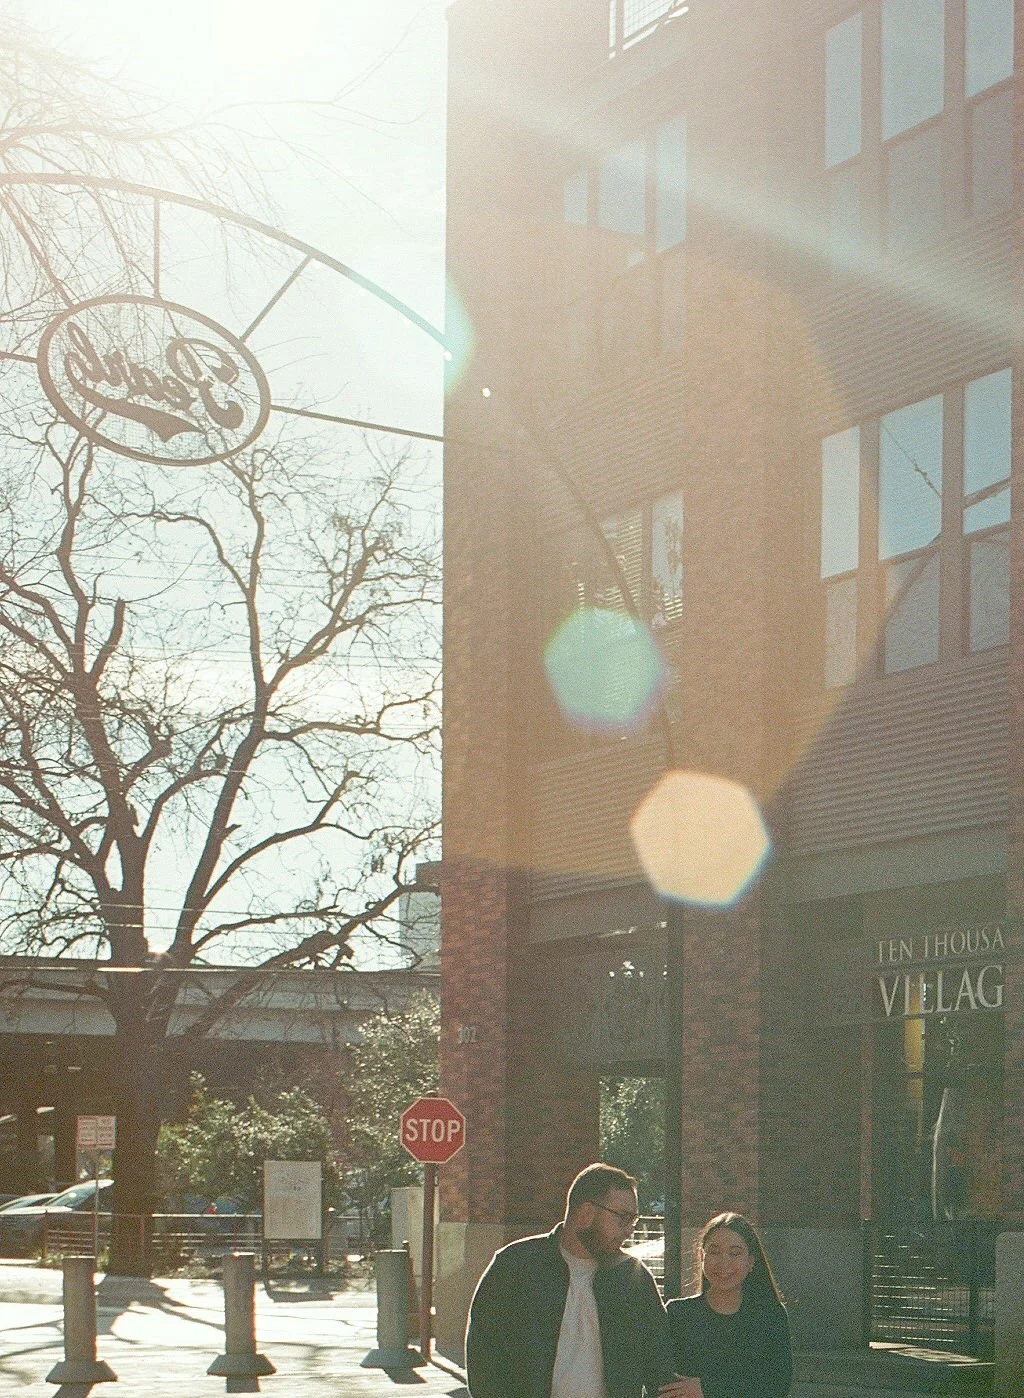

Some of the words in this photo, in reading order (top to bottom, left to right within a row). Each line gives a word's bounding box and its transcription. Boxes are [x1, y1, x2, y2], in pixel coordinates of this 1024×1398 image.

[877, 937, 914, 963] TEN
[922, 926, 1005, 957] THOUSA
[878, 964, 1005, 1017] VILLAG
[405, 1118, 461, 1143] STOP
